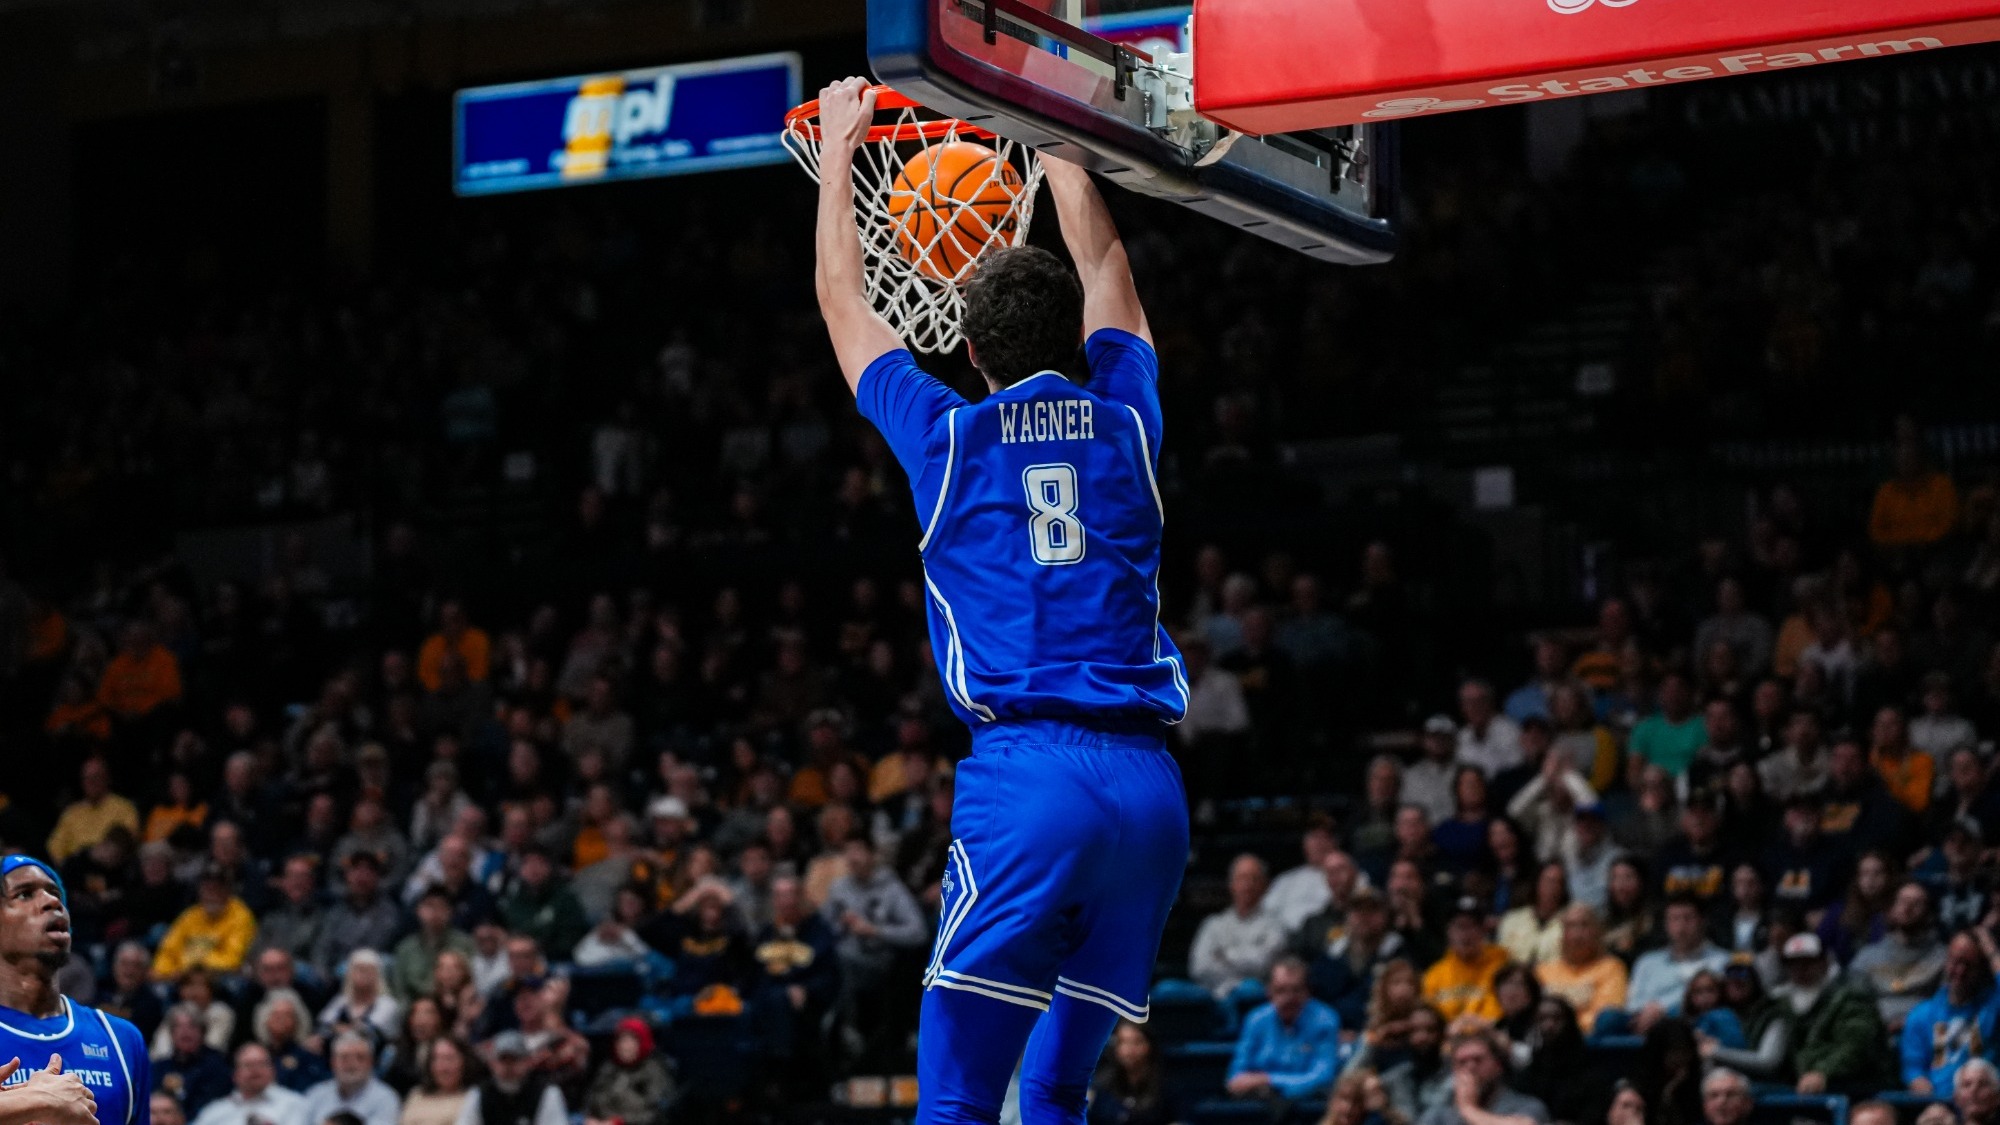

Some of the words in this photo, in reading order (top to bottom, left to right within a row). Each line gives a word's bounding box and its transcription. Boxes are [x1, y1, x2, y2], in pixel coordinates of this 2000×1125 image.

[1487, 65, 1715, 102] State
[1717, 36, 1945, 74] Farm
[998, 399, 1095, 444] WAGNER
[1021, 462, 1087, 566] 8
